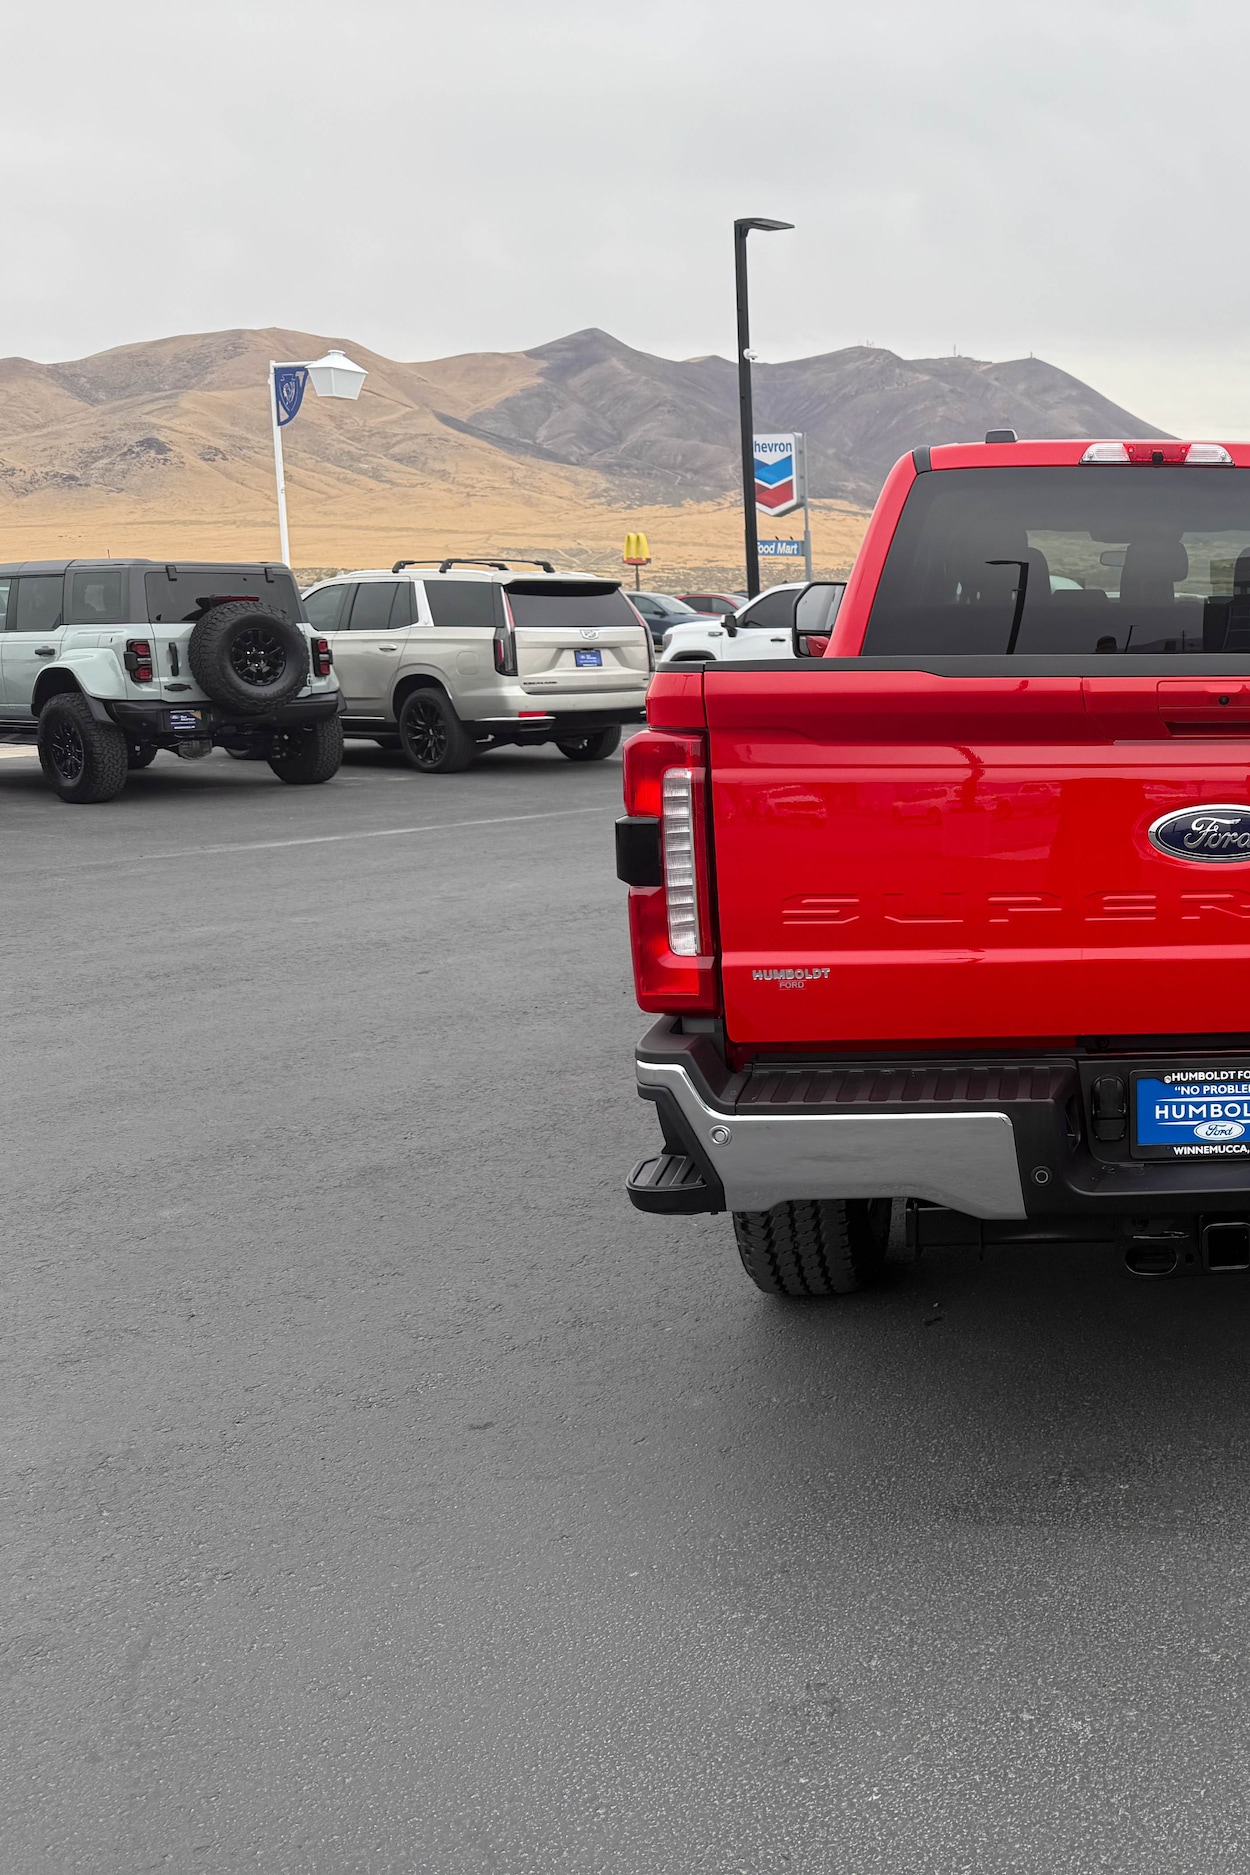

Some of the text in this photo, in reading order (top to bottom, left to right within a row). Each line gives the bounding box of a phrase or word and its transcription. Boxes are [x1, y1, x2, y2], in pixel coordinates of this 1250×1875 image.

[752, 440, 793, 453] hevron
[777, 541, 798, 554] Mart
[752, 967, 831, 981] HUMBOLDT
[779, 981, 805, 989] FORD
[1172, 1071, 1236, 1082] HUMBOLDT
[1205, 1124, 1233, 1136] Ford
[1173, 1145, 1250, 1155] WINNEMUCCA,
